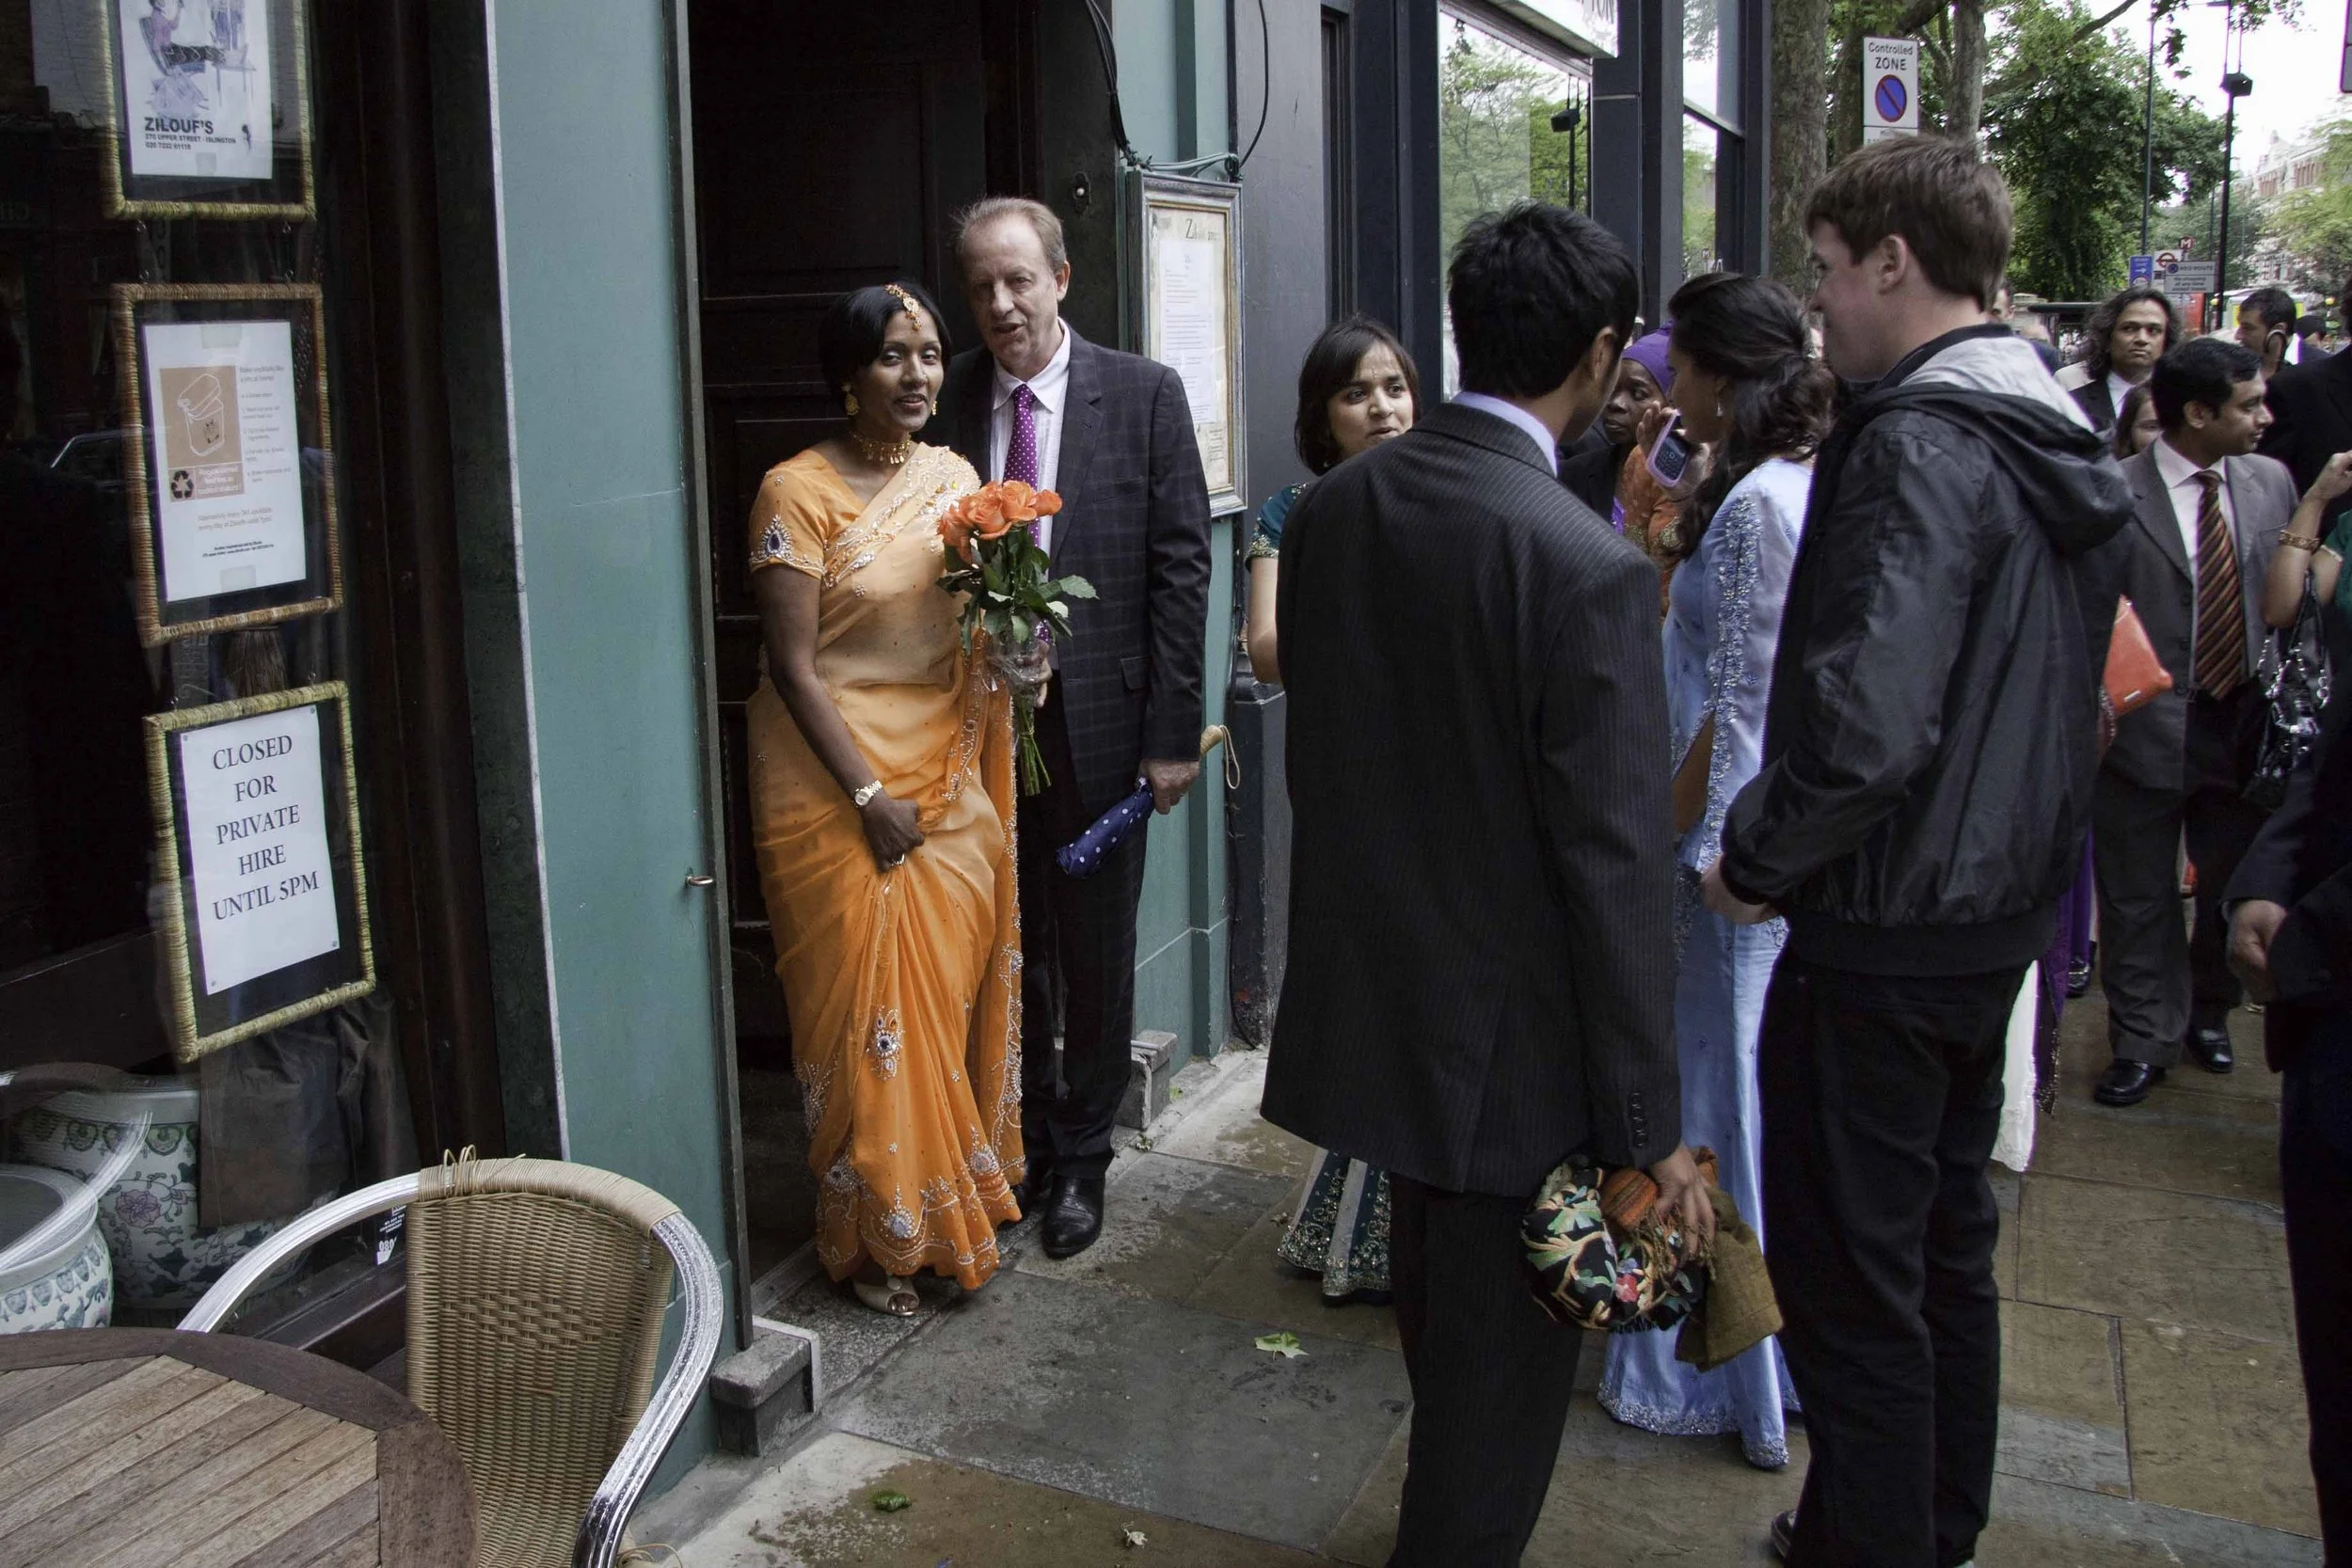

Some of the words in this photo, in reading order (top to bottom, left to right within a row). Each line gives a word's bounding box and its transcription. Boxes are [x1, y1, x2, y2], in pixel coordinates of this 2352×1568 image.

[1868, 41, 1914, 55] Controlled
[1875, 56, 1907, 71] ZONE
[144, 117, 215, 135] ZILOUF'S
[213, 735, 293, 770] CLOSED
[234, 775, 278, 802] FOR
[216, 804, 300, 845] PRIVATE
[238, 844, 287, 877] HIRE
[213, 885, 276, 920] UNTIL
[279, 870, 320, 900] 5PM
[378, 1237, 397, 1252] 080
